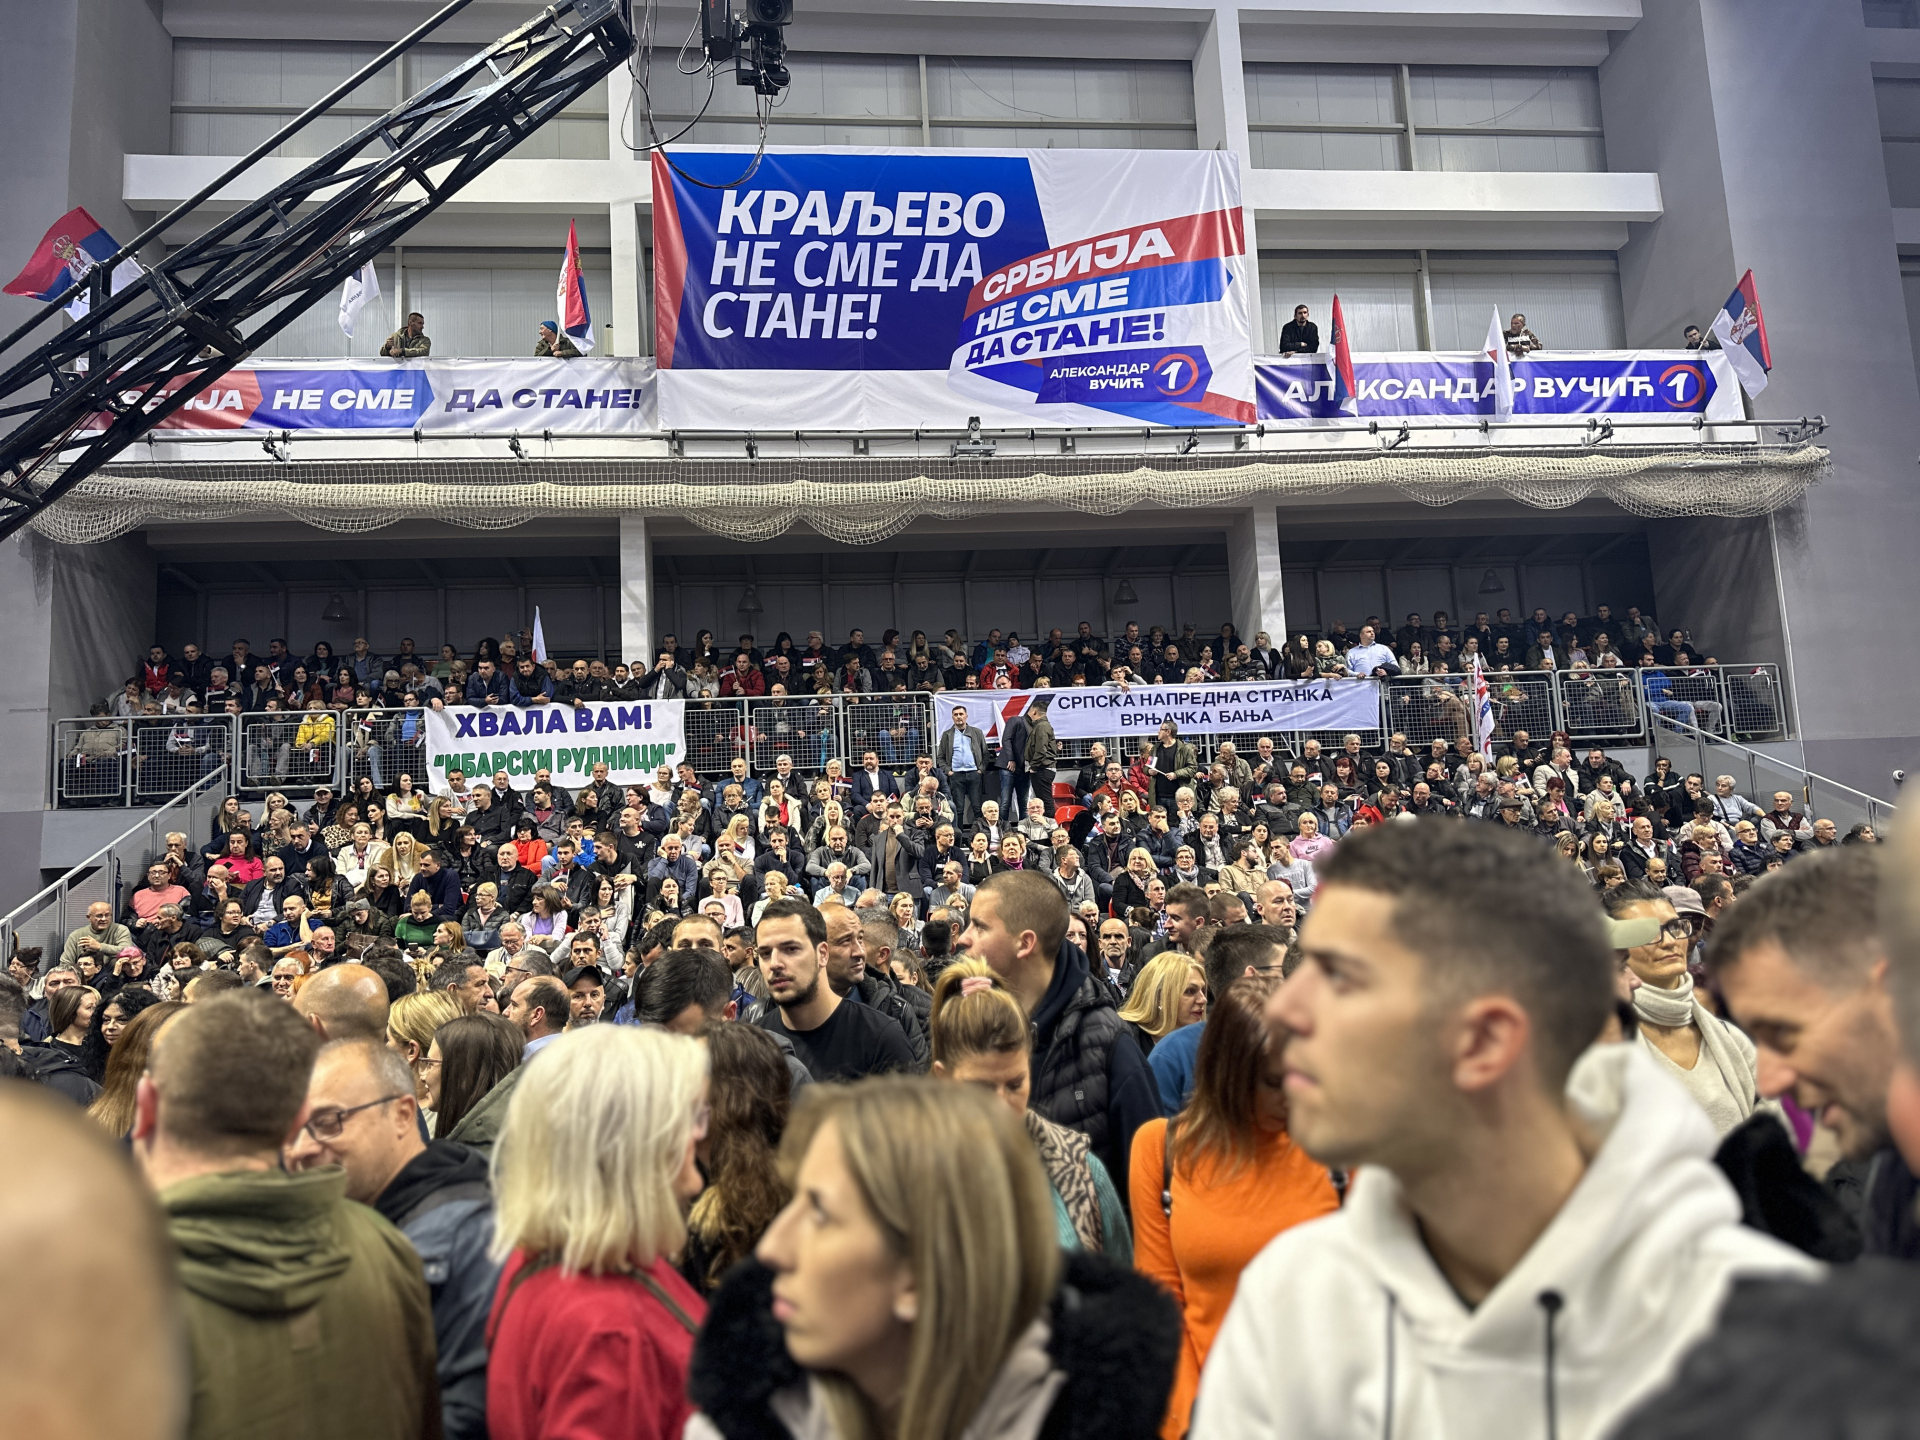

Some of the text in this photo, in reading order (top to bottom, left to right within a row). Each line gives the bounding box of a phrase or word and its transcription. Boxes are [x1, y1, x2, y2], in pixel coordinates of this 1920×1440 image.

[717, 189, 1006, 238] КРАЉЕВО
[710, 239, 984, 293] НЕ СМЕ ДА
[983, 228, 1176, 302] СРБИЈА
[702, 291, 882, 340] СТАНЕ!
[975, 276, 1130, 337] НЕ СМЕ
[964, 312, 1166, 369] ДА СТАНЕ!
[1049, 363, 1150, 380] АЛЕКСАНДАР
[1089, 377, 1145, 391] ВУЧИЋ
[1161, 361, 1183, 390] 1
[1533, 376, 1655, 399] ВУЧИЋ
[1667, 372, 1689, 402] 1
[271, 388, 324, 411] НЕ
[329, 388, 416, 411] СМЕ
[444, 388, 503, 413] ДА
[510, 388, 642, 411] СТАНЕ!
[1057, 687, 1334, 711] СРПСКА НАПРЕДНА СТРАНКА
[455, 704, 653, 738] ХВАЛА ВАМ!
[1120, 709, 1274, 727] ВРЊАЧКА БАЊА
